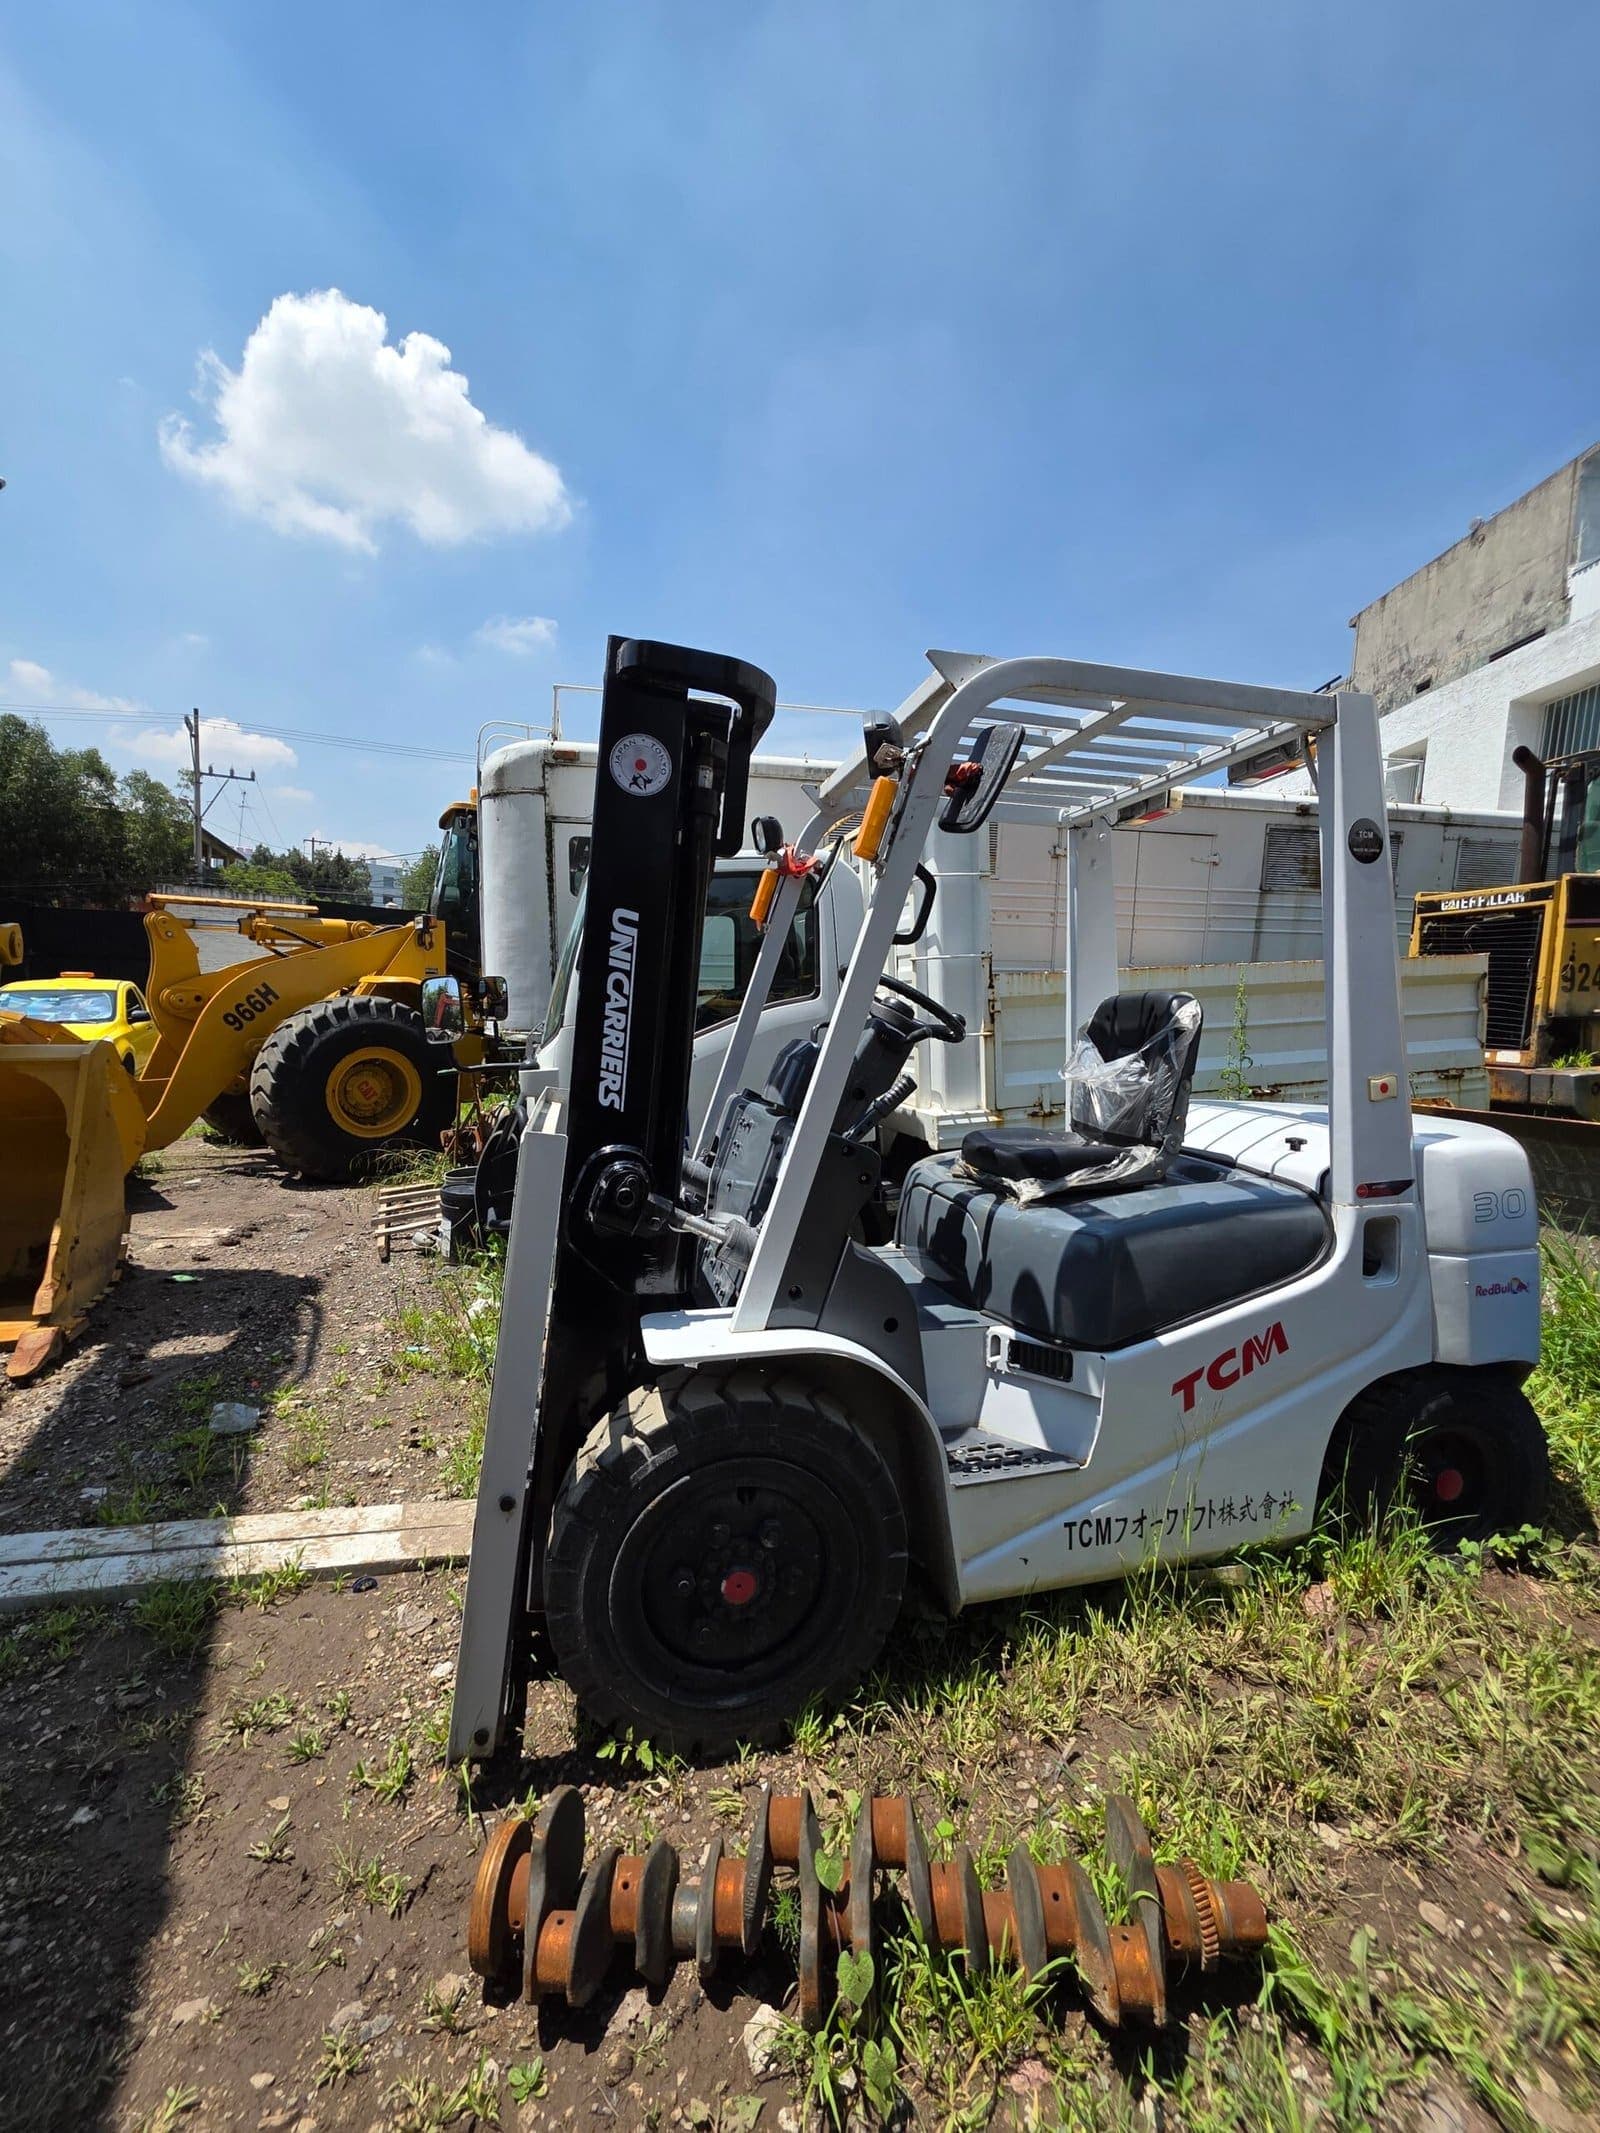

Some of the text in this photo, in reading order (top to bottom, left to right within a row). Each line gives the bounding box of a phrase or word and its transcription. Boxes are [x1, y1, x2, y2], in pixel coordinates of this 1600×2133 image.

[614, 738, 668, 776] JAPAN TOKYO
[1359, 830, 1374, 839] TCM
[223, 981, 281, 1032] 966H
[598, 907, 640, 1113] UNICARRIERS
[1473, 1188, 1527, 1223] 30
[1171, 1321, 1290, 1414] TCM
